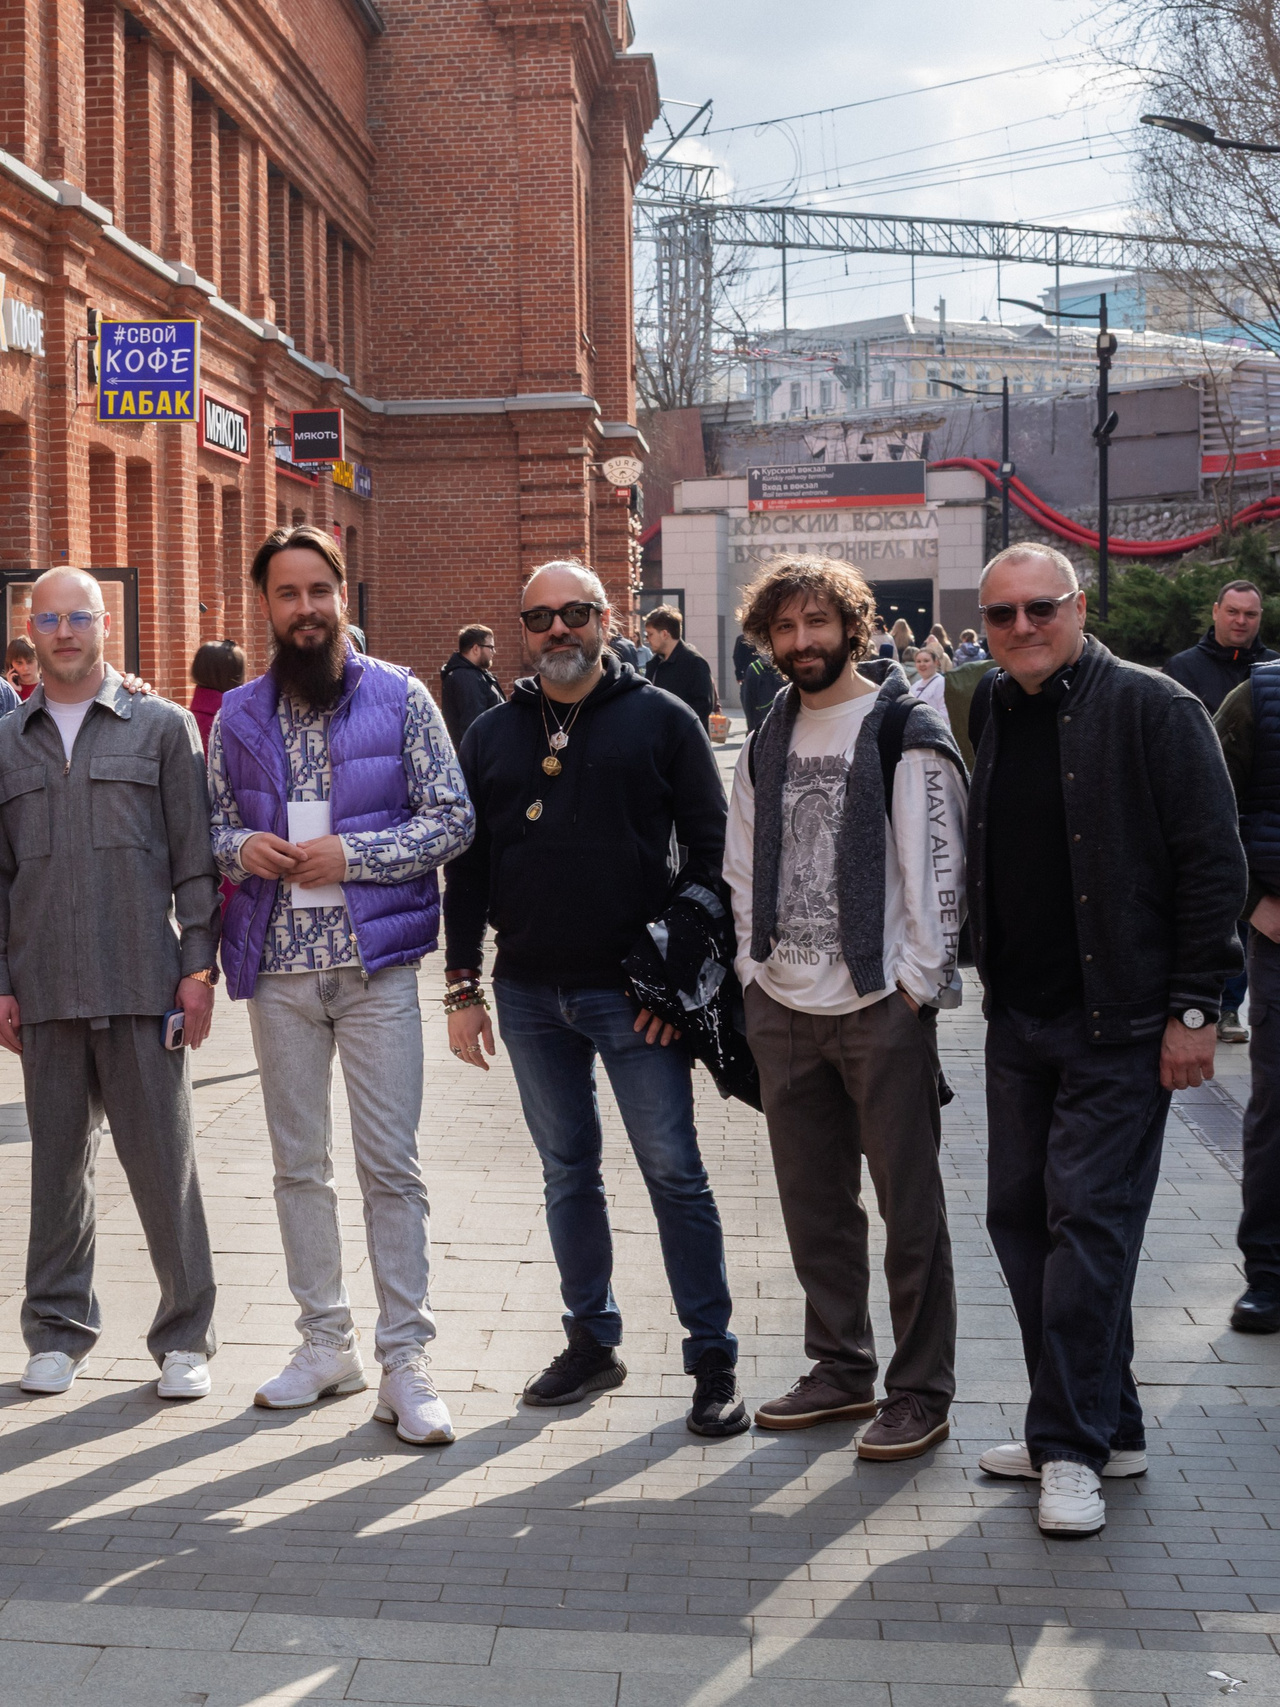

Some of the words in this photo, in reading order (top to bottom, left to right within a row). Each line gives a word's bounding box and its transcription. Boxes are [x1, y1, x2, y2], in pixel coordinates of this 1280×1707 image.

[11, 298, 46, 357] КОФЕ
[113, 324, 177, 346] #СВОЙ
[105, 347, 191, 374] КОФЕ
[103, 390, 191, 415] ТАБАК
[205, 399, 248, 454] МЯКОТЬ
[294, 431, 339, 441] МЯКОТЬ
[608, 460, 637, 469] SURF
[761, 466, 796, 476] Курский
[797, 465, 826, 473] вокзал
[610, 475, 637, 483] COFFEE
[762, 483, 783, 492] Вход
[734, 513, 839, 535] КУРСКИЙ
[852, 510, 939, 532] ВОКЗАЛ
[925, 770, 947, 827] MAY
[930, 834, 952, 883] ALL
[938, 889, 958, 924] BE
[777, 949, 820, 966] MIND
